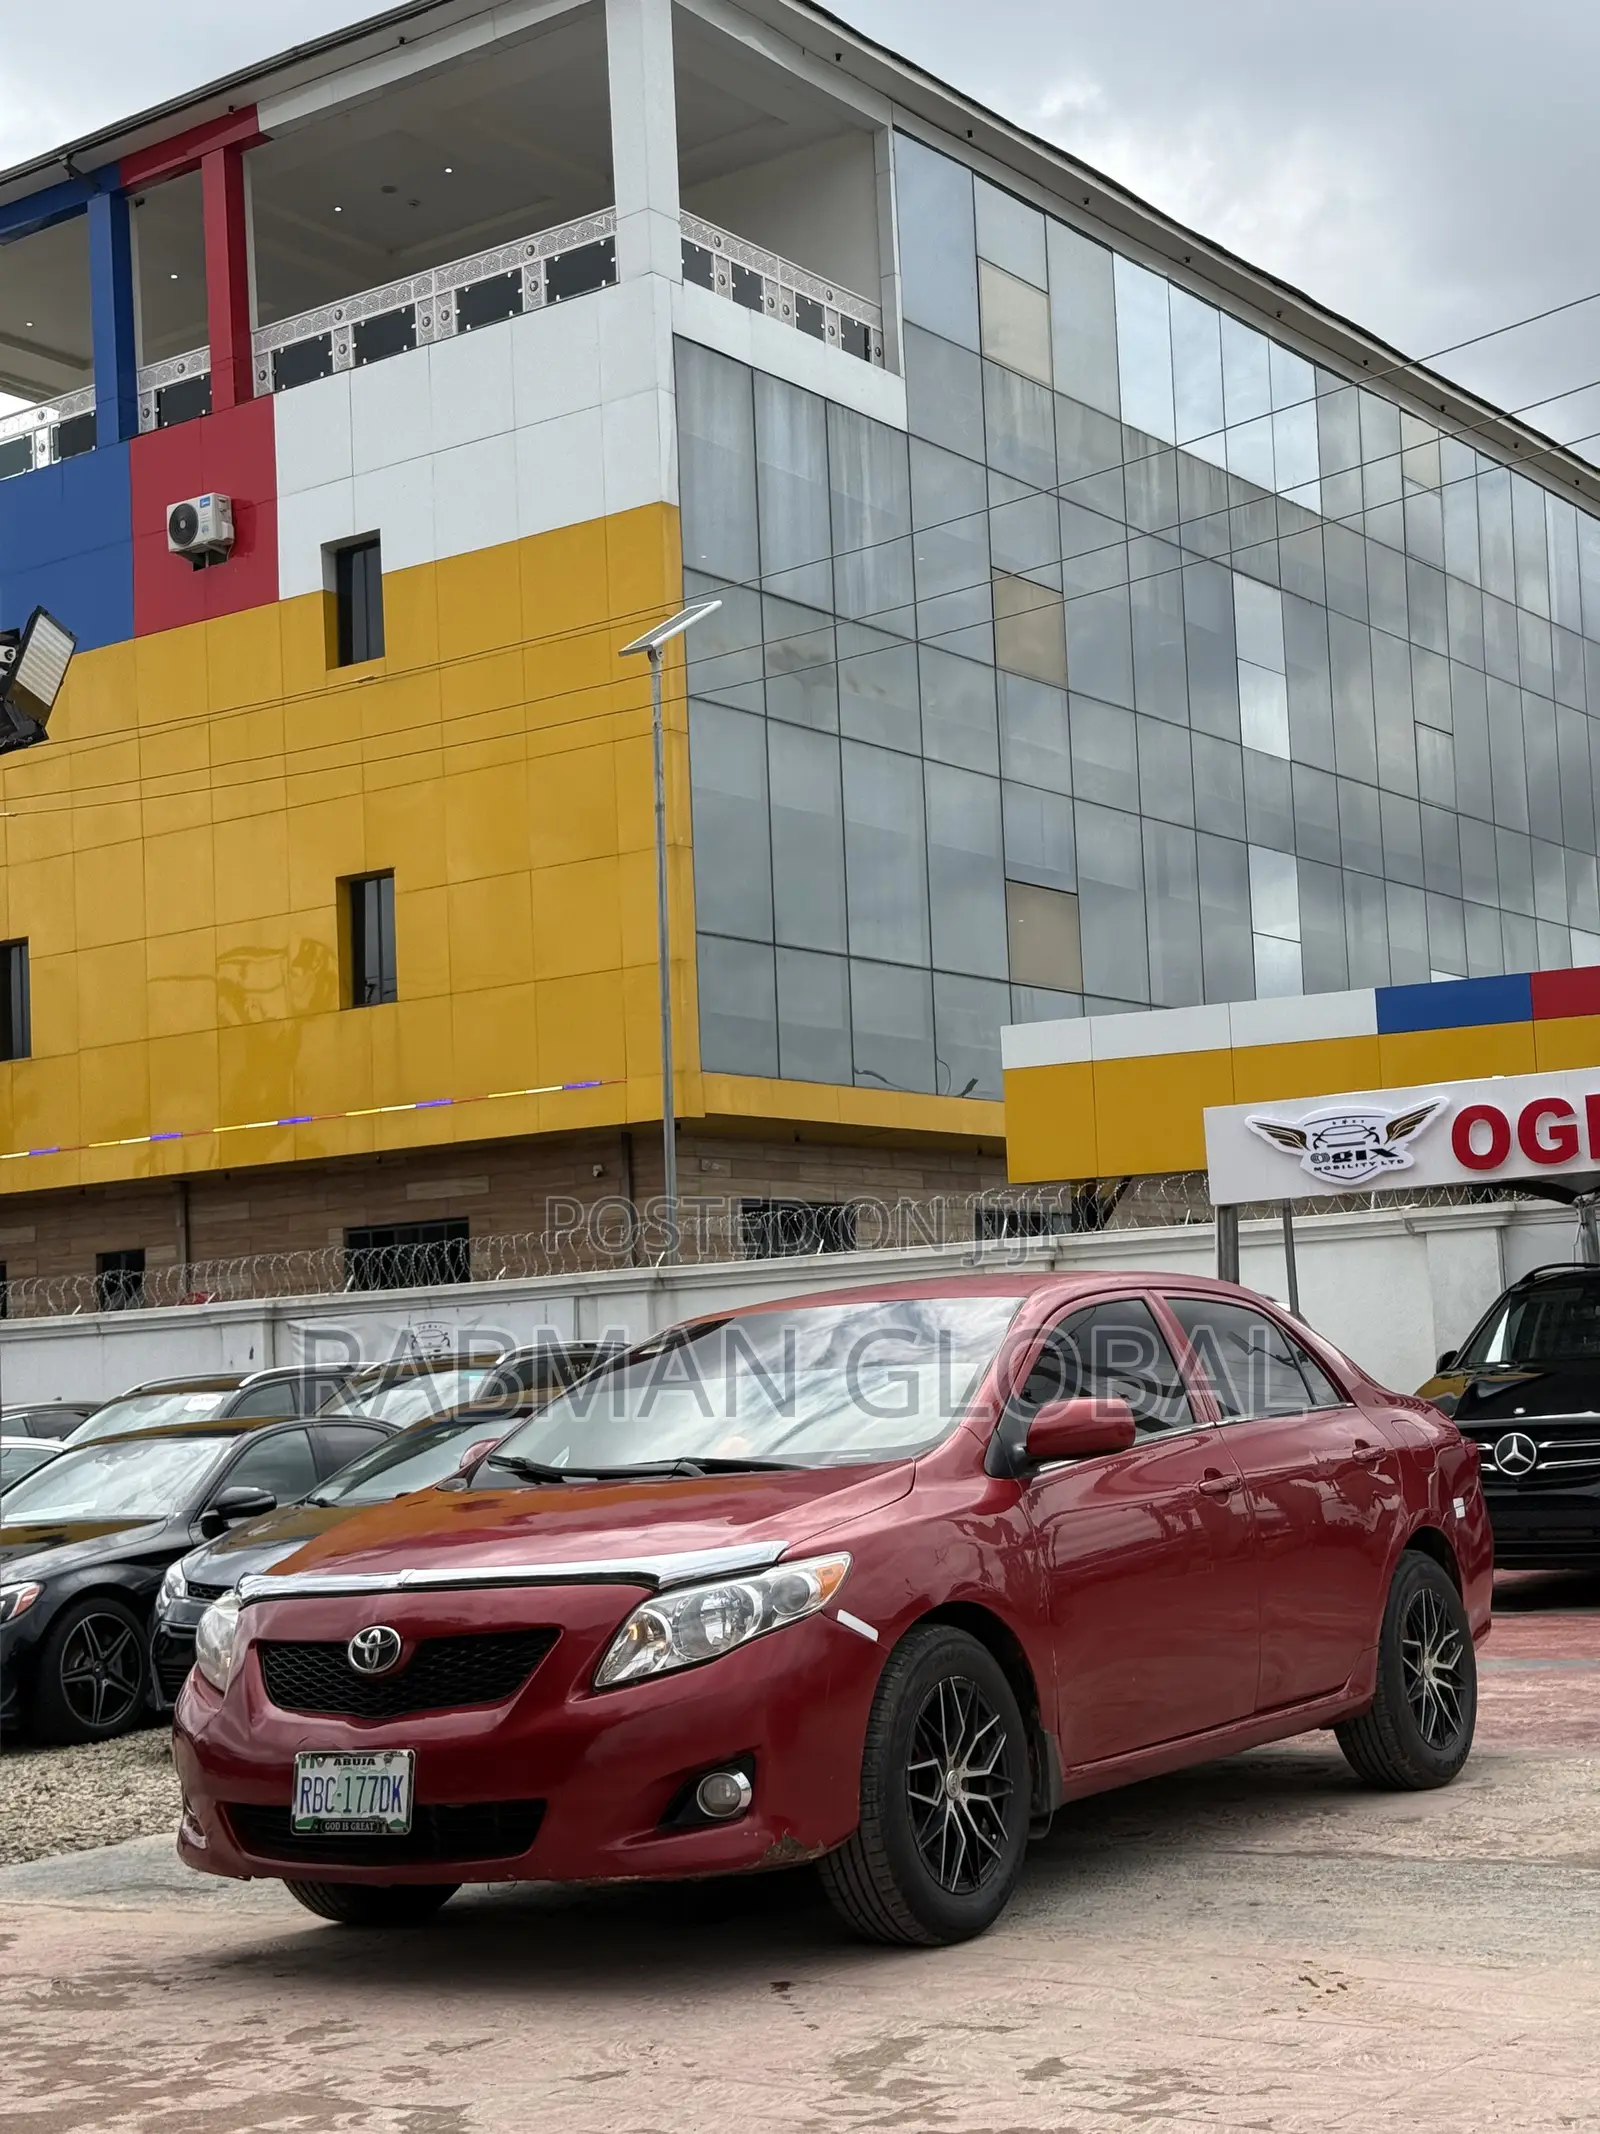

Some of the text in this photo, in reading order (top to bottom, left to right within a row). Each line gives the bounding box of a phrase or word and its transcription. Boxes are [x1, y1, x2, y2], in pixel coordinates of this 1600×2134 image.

[1314, 1158, 1405, 1171] MOBILITY LTD
[333, 1758, 376, 1766] ABUJA
[325, 1821, 375, 1831] GOD IS GREAT
